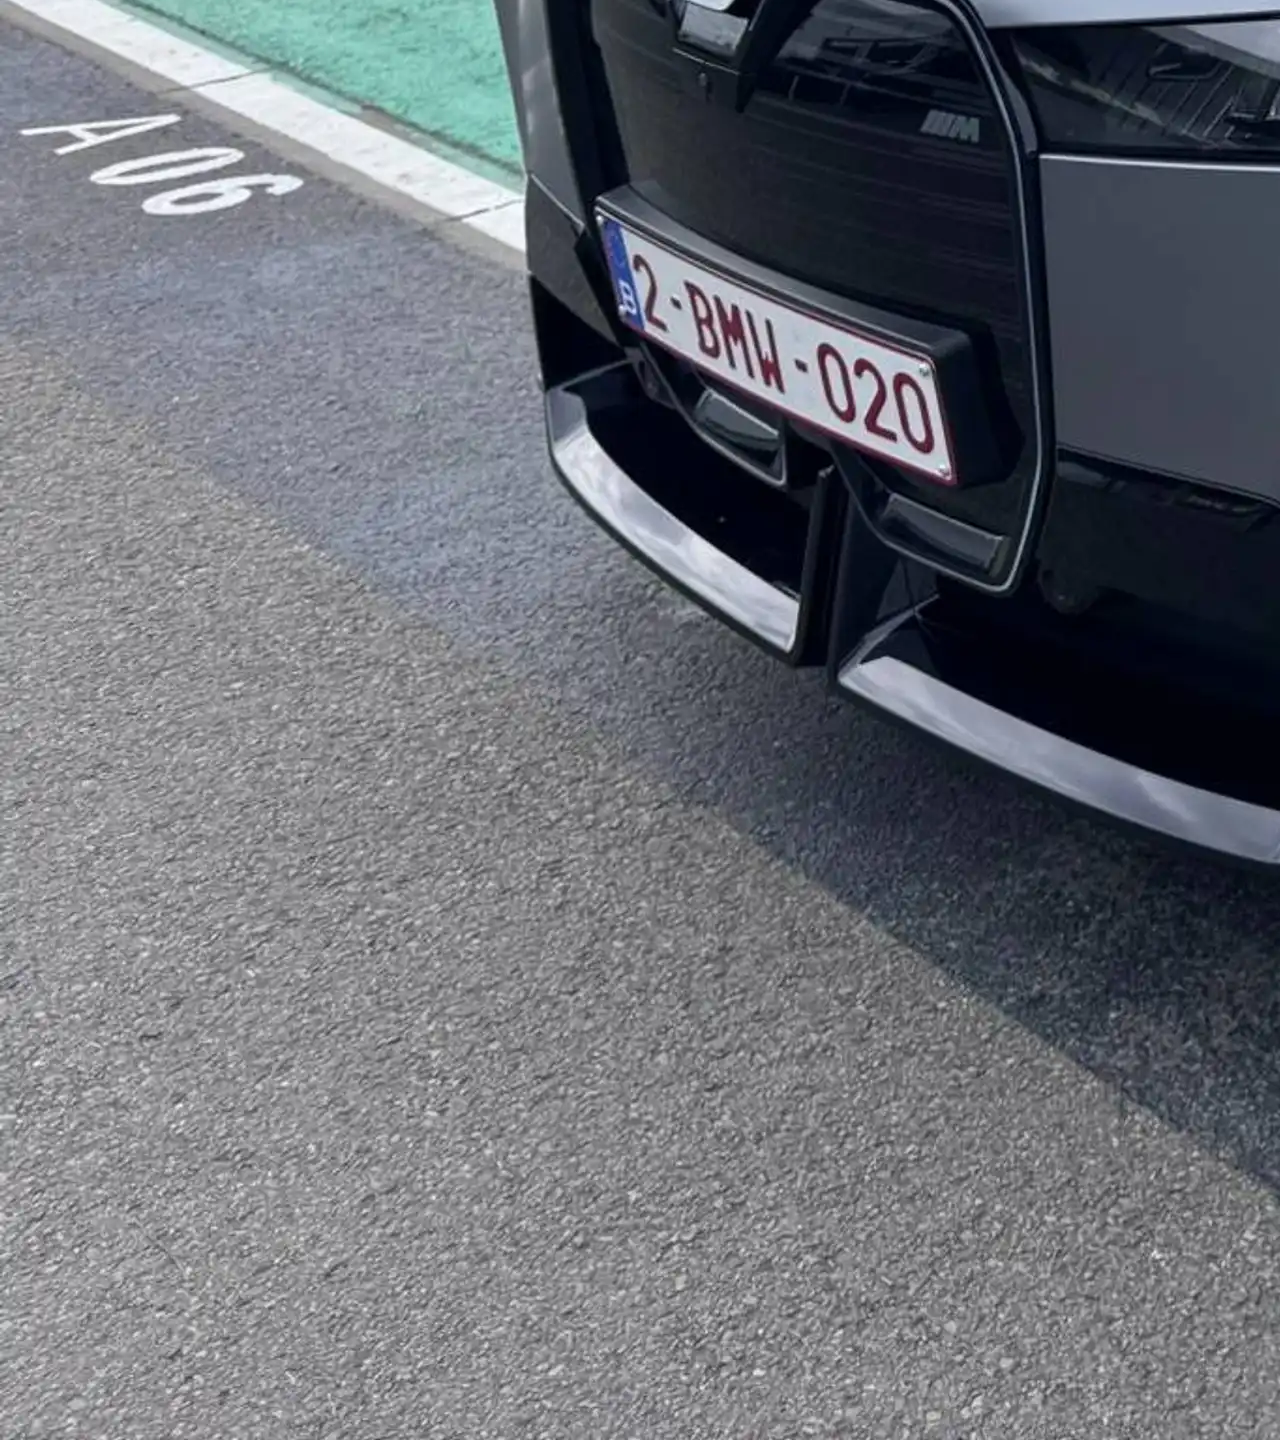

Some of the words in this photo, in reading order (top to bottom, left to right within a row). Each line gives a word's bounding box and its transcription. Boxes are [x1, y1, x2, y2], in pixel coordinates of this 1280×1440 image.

[20, 113, 182, 156] A
[89, 147, 304, 216] 06
[632, 254, 935, 455] 2-BMW-020
